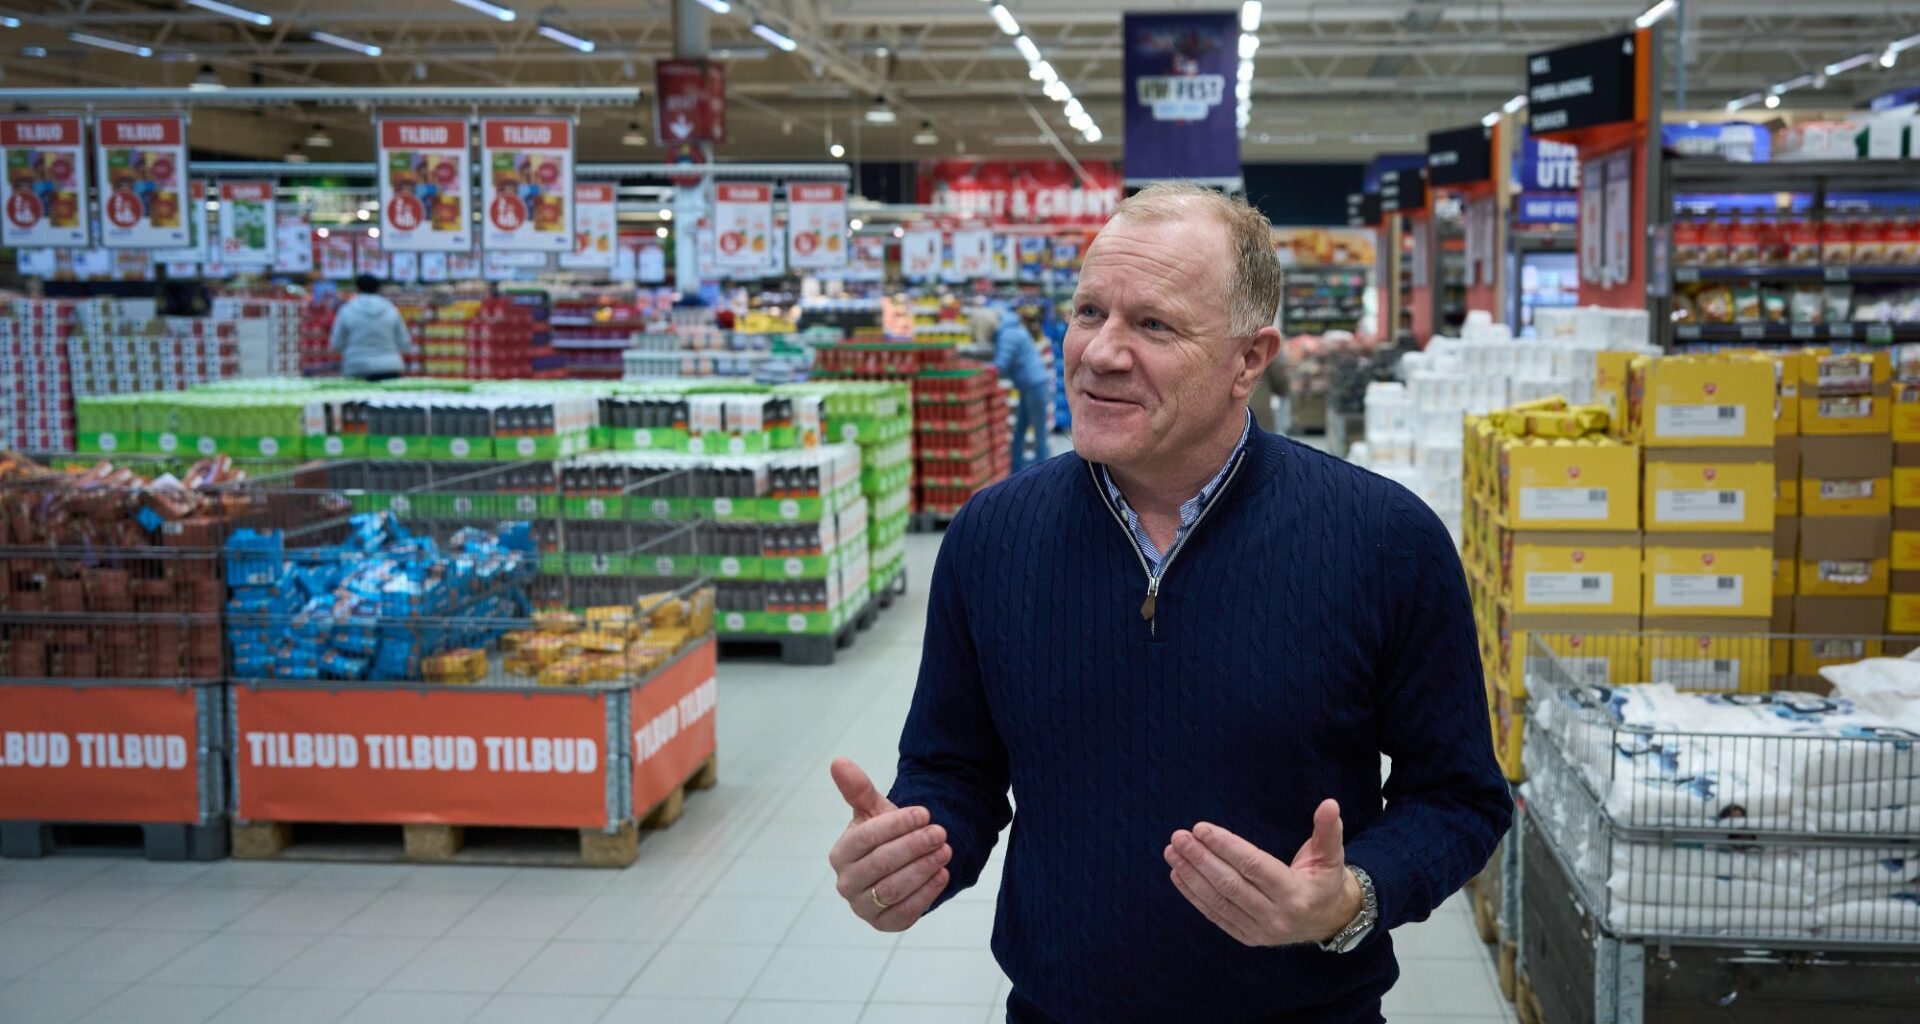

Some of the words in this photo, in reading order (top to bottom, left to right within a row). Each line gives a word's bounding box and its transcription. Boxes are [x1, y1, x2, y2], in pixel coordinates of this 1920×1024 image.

[16, 124, 63, 142] TILBUD
[116, 124, 164, 142] TILBUD
[399, 126, 448, 144] TILBUD
[502, 126, 551, 144] TILBUD
[1537, 160, 1581, 188] UTE
[634, 703, 679, 765] TILBUD
[76, 733, 188, 769] TILBUD
[246, 732, 359, 769] TILBUD
[364, 734, 478, 771] TILBUD
[484, 737, 598, 774] TILBUD
